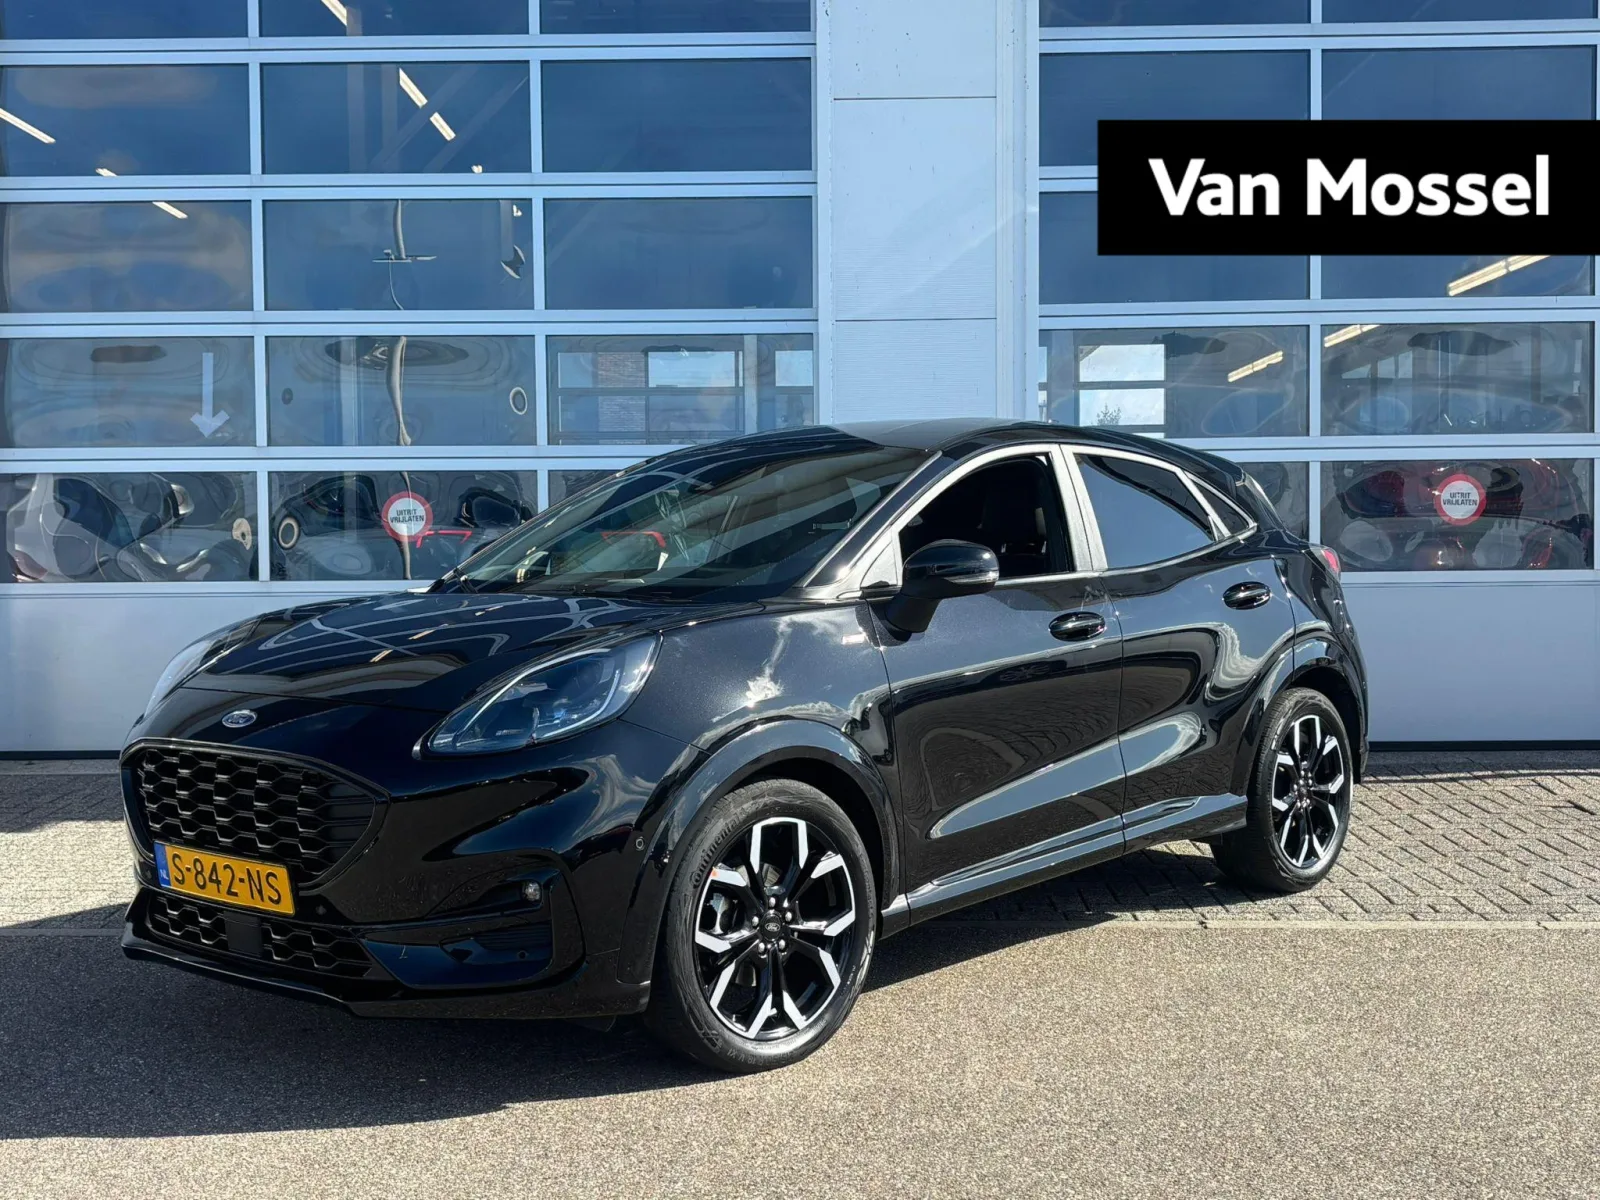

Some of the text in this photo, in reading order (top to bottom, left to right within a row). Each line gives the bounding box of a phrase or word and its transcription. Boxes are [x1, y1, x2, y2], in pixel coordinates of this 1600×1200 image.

[1449, 491, 1471, 499] UITRIT
[1442, 498, 1478, 506] VRIJLATEN
[396, 508, 418, 517] UITRIT
[390, 514, 425, 524] VRIJLATEN
[160, 869, 169, 880] NL
[171, 852, 282, 905] S-842-NS
